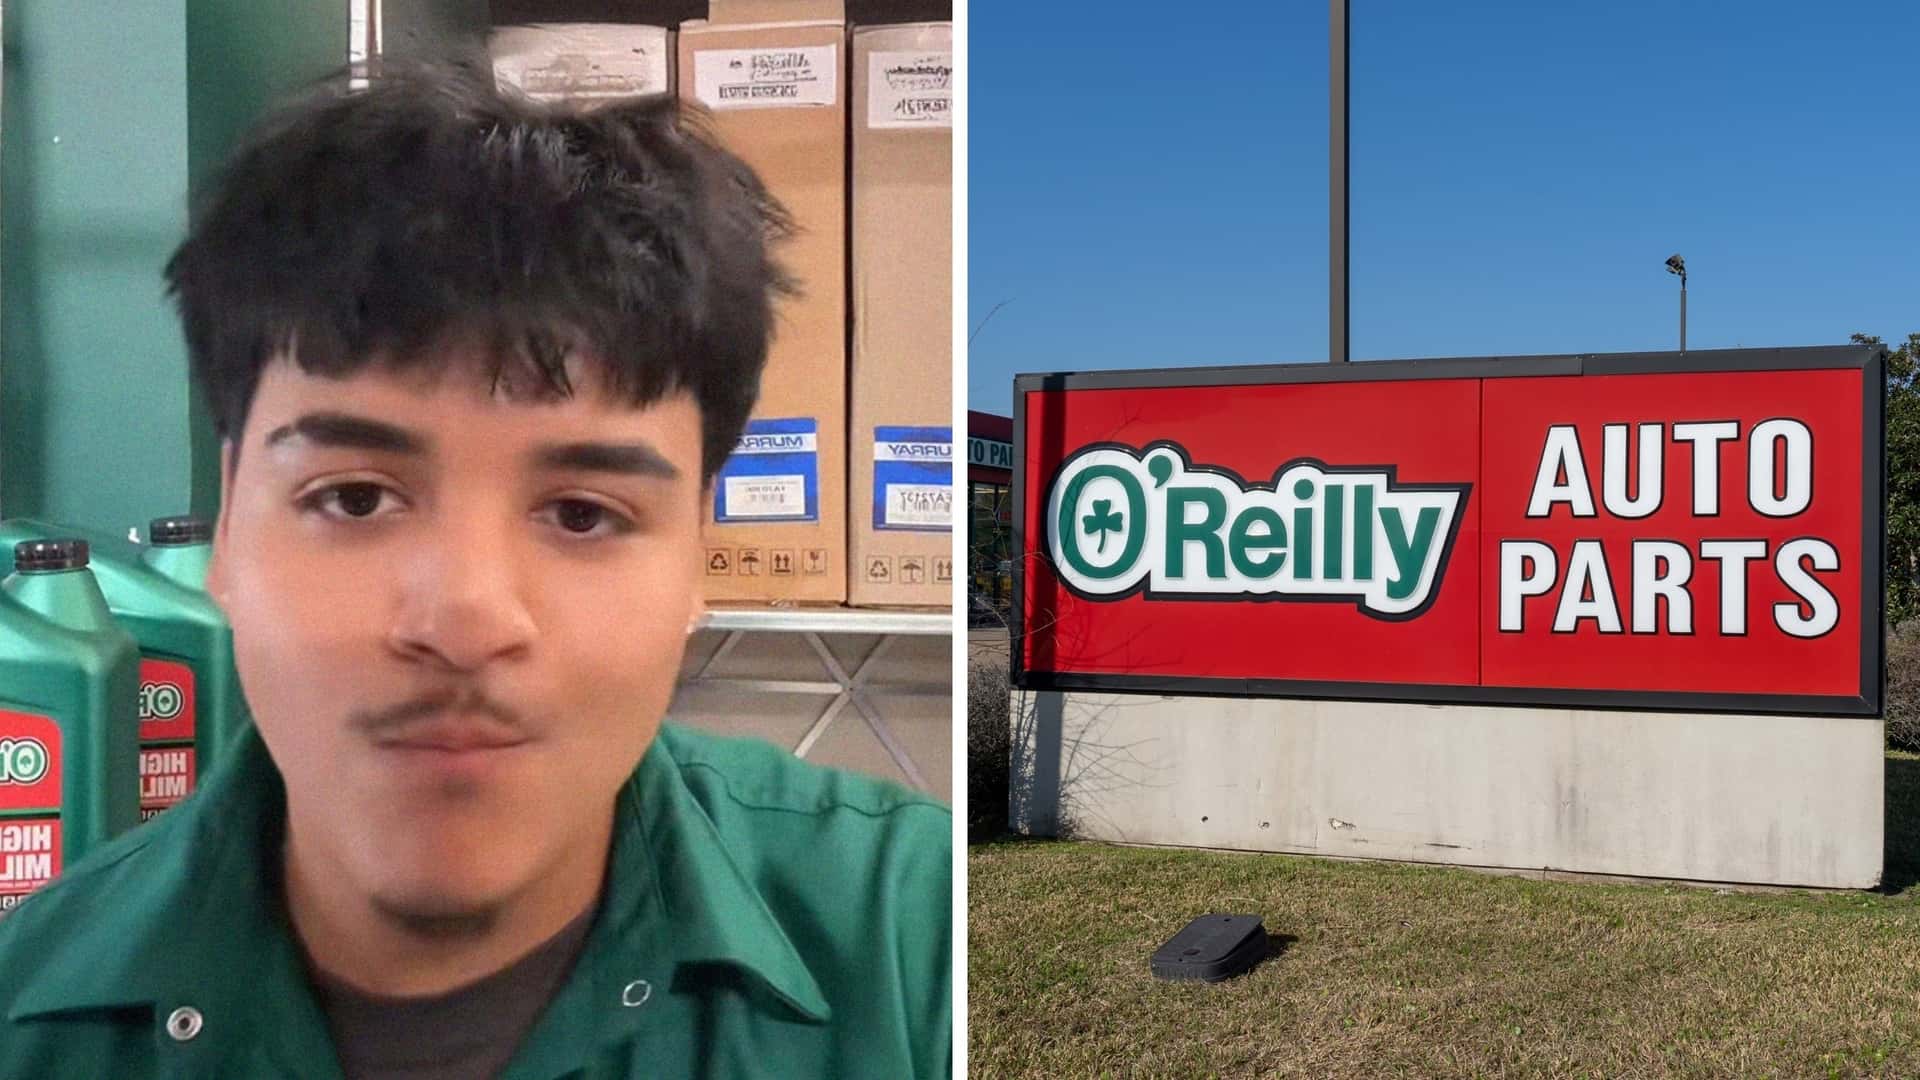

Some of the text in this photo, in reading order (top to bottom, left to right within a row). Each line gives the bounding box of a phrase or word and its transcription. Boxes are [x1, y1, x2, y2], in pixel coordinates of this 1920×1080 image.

[1525, 417, 1815, 519] AUTO
[1057, 453, 1442, 601] O'Reilly
[1498, 537, 1841, 639] PARTS
